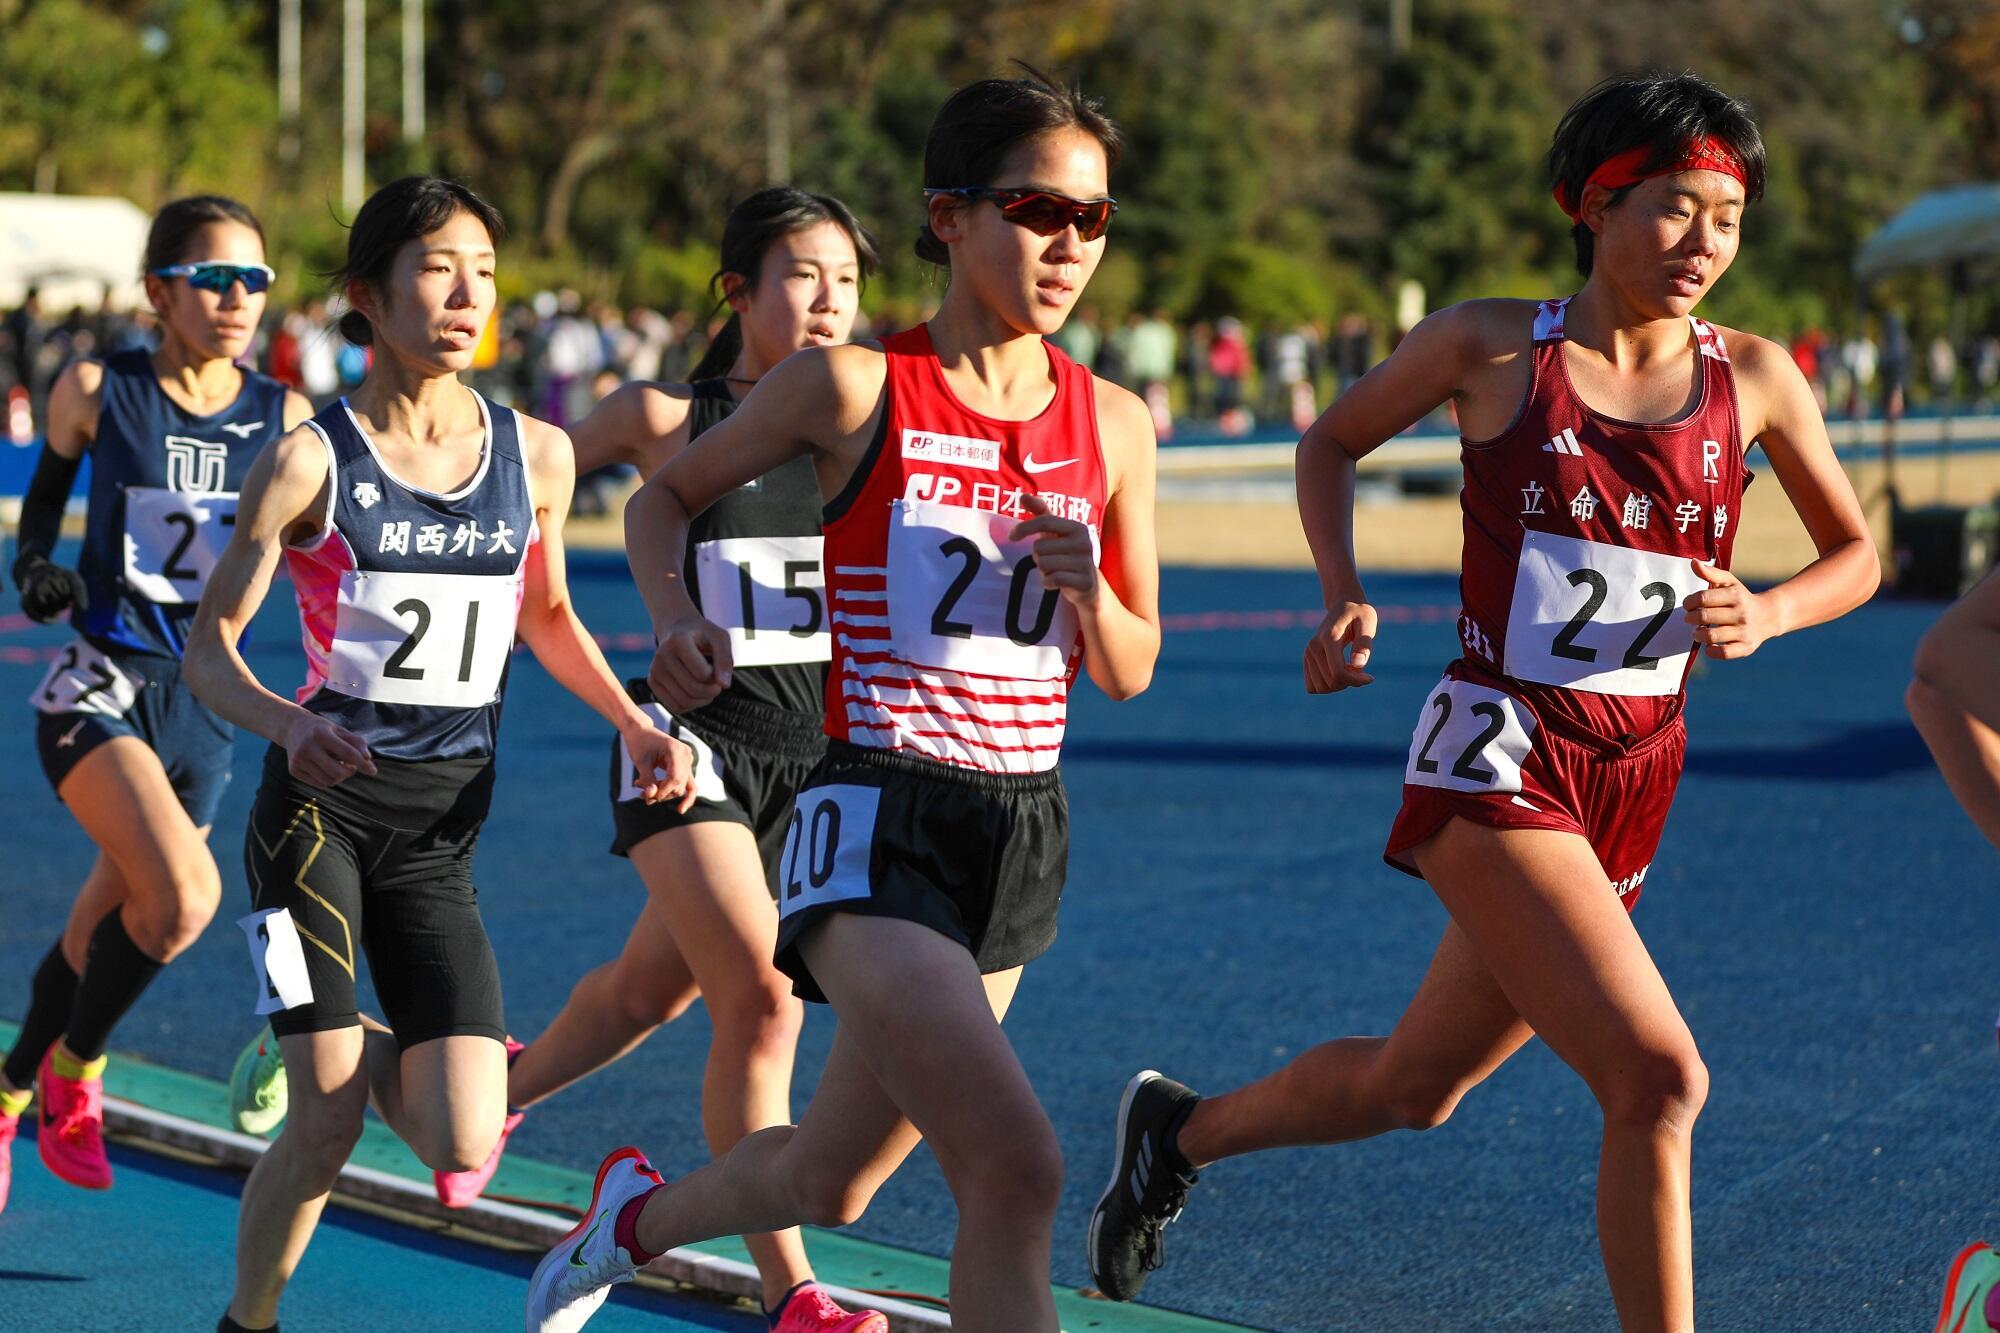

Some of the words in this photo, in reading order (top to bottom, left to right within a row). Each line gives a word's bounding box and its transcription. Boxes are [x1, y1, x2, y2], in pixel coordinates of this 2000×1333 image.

[940, 442, 994, 462] 日本郵便
[1703, 440, 1721, 478] R
[163, 511, 236, 581] 2
[378, 519, 517, 557] 関西外大
[738, 560, 822, 640] 15
[930, 536, 1060, 647] 20
[1550, 568, 1677, 671] 22
[382, 598, 480, 682] 21
[1415, 692, 1506, 785] 22
[787, 798, 842, 900] 20
